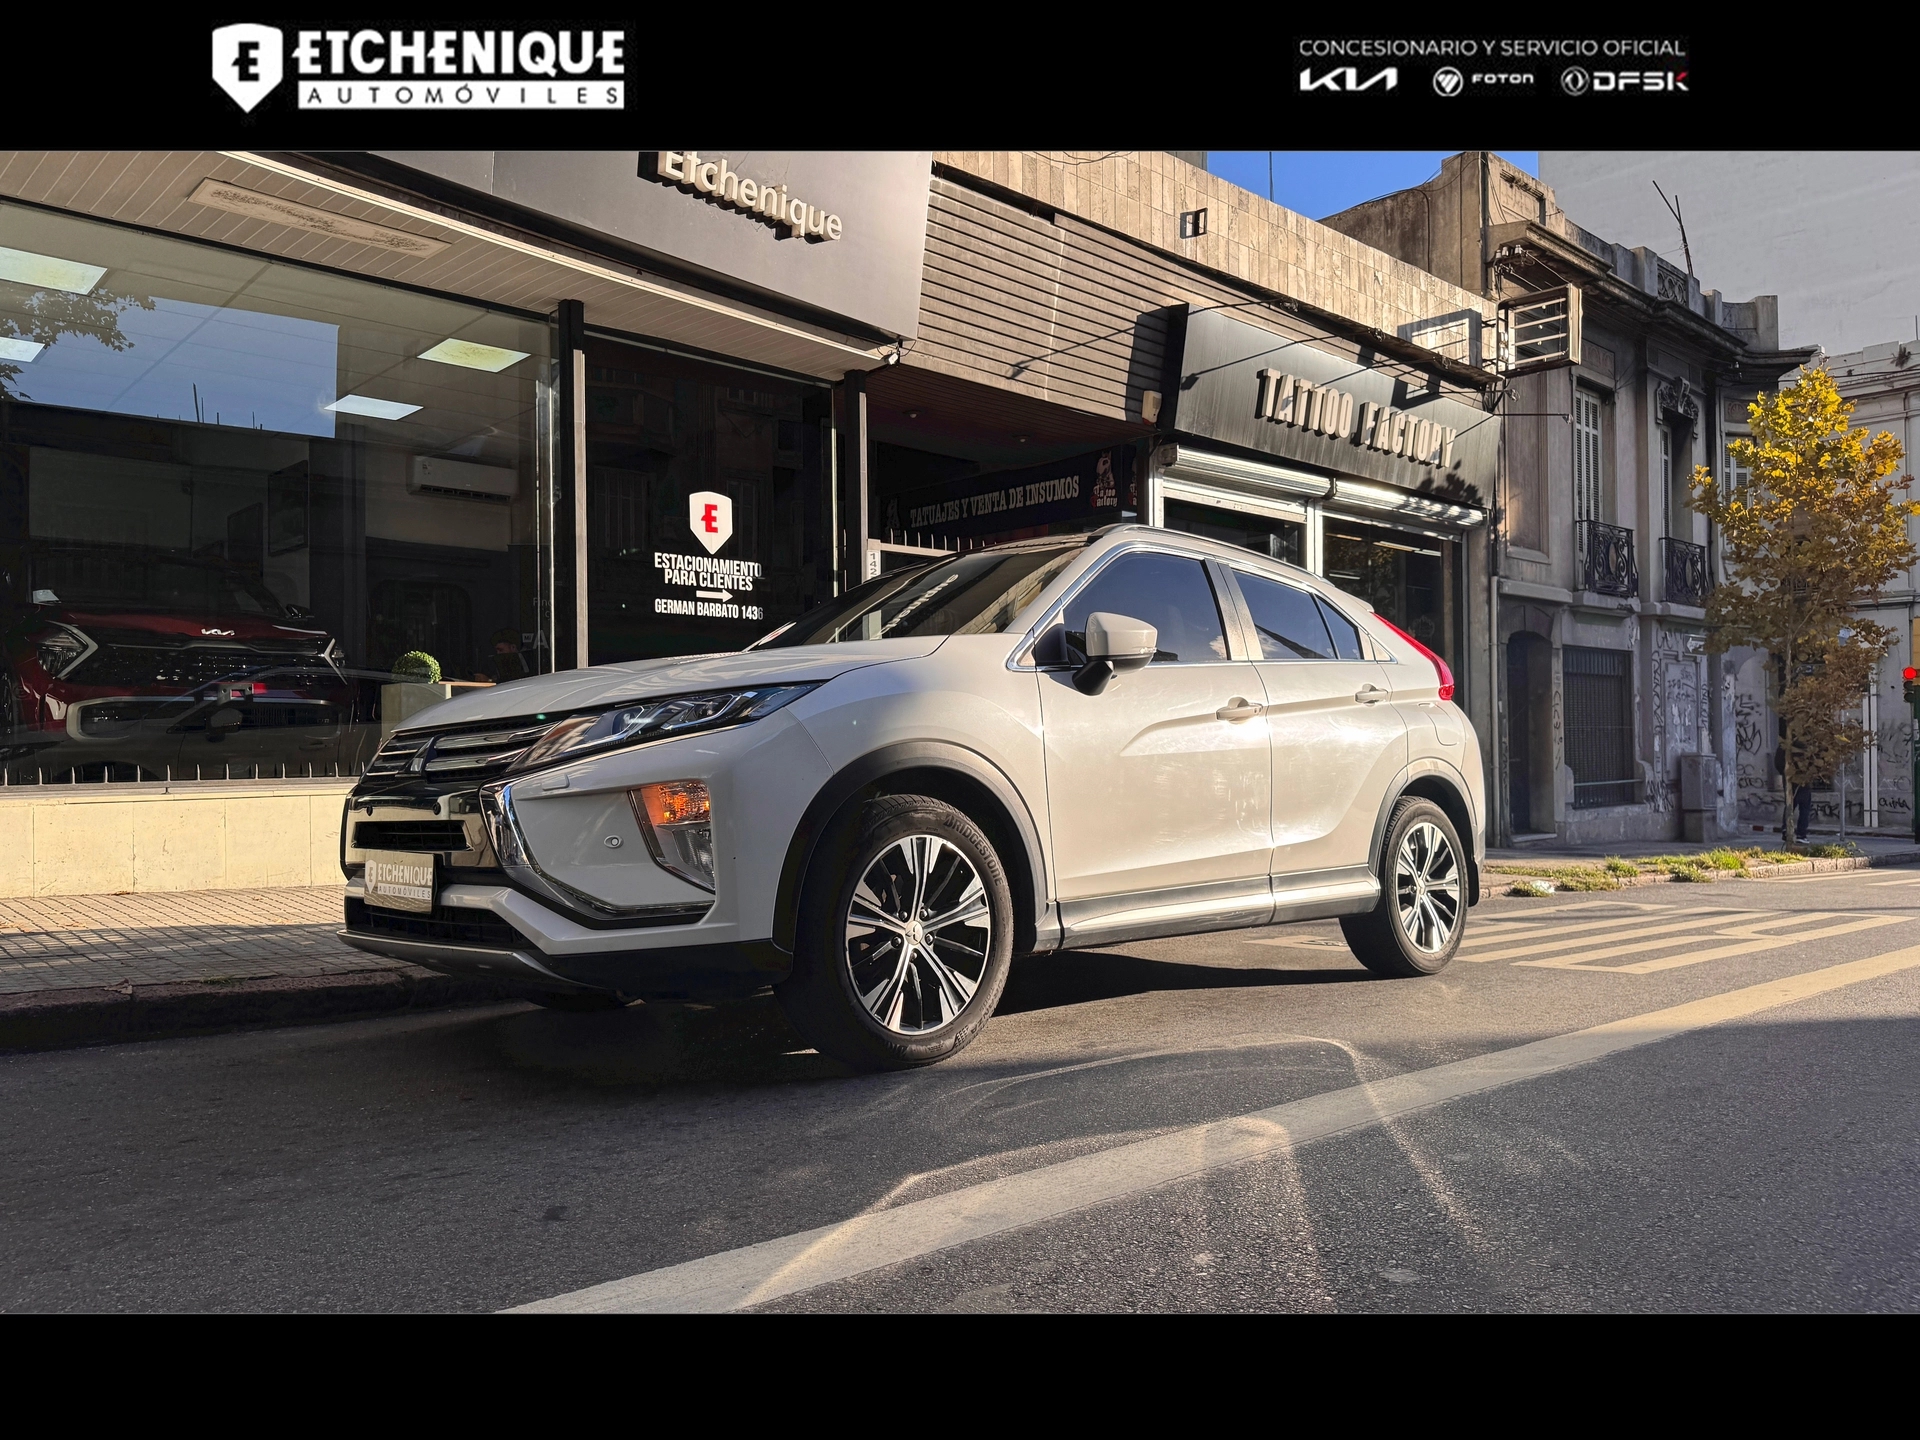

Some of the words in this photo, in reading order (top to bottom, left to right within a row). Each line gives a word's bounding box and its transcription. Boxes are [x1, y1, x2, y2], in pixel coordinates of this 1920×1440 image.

[657, 151, 843, 241] Etchenique
[1262, 368, 1354, 439] TATTOO
[1360, 401, 1457, 468] FACTORY
[910, 500, 960, 528] TATUAJES
[960, 498, 970, 518] Y
[970, 490, 1007, 516] VENTA
[1008, 486, 1024, 510] DE
[1025, 475, 1080, 506] INSUMOS
[654, 552, 763, 578] ESTACIONAMIENTO
[869, 552, 878, 577] 142
[664, 568, 697, 586] PARA
[699, 571, 754, 591] CLIENTES
[654, 598, 696, 616] GERMAN
[696, 601, 739, 619] BARBATO
[741, 605, 764, 621] 1436
[943, 813, 1002, 887] BRIDGESTONE
[377, 863, 433, 886] ETCHENIQUE
